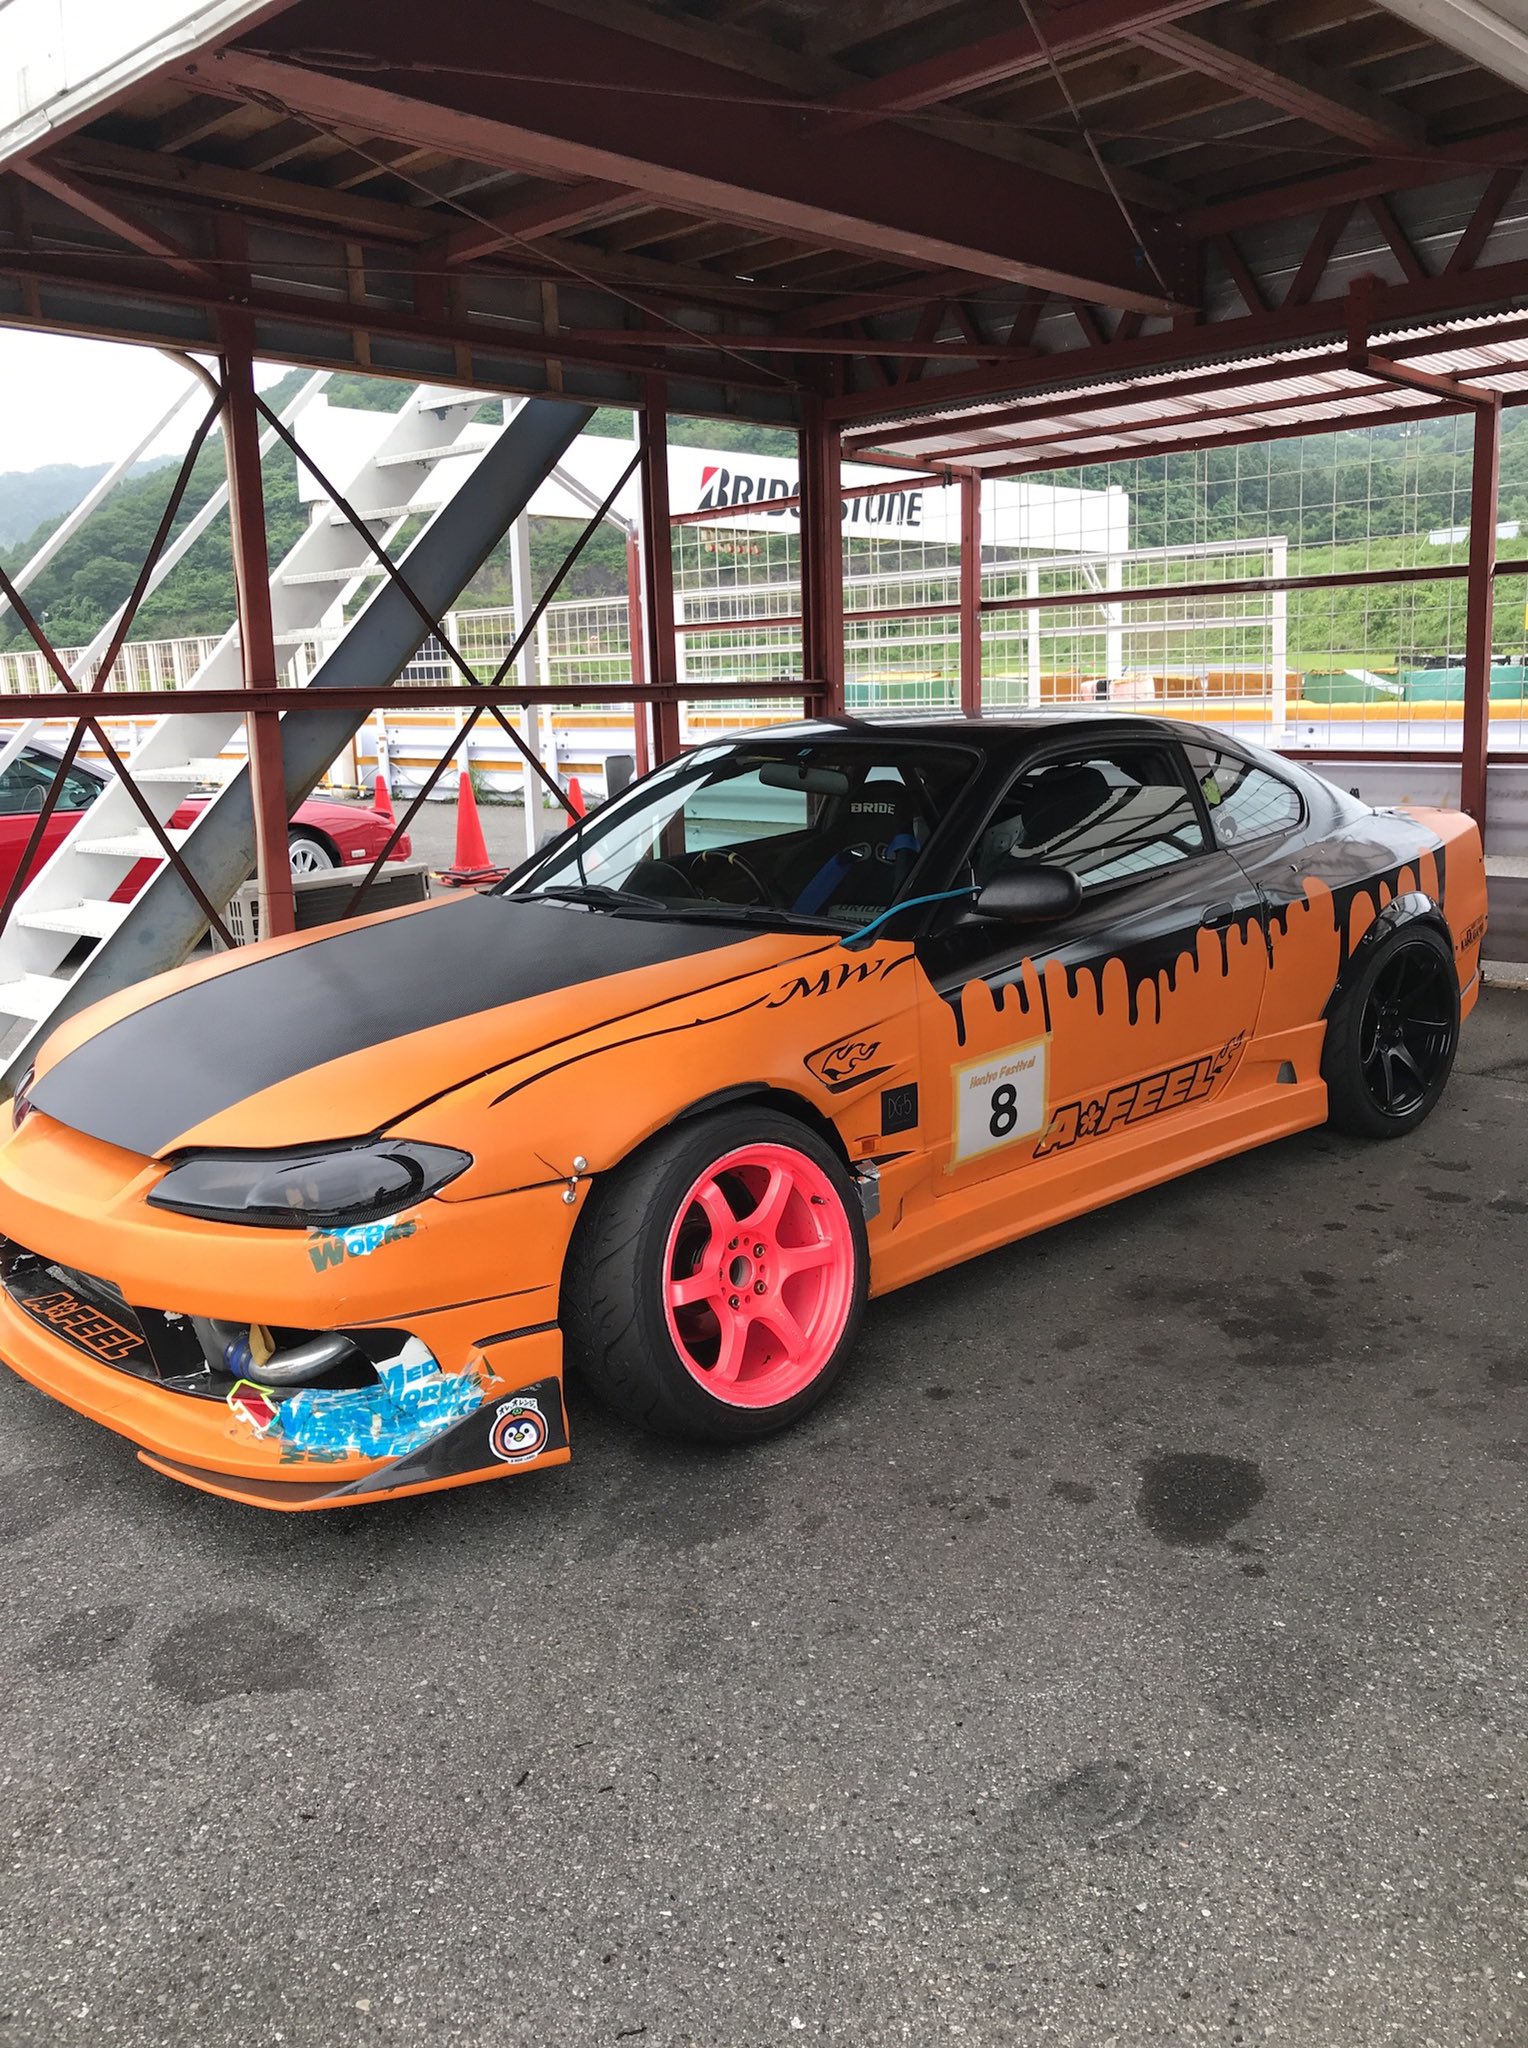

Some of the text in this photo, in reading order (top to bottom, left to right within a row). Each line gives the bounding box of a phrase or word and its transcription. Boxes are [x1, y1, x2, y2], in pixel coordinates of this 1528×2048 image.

[697, 467, 923, 527] BRIDTONE
[850, 802, 896, 815] BRIDE
[989, 1083, 1018, 1138] 8
[379, 1358, 438, 1399] MED
